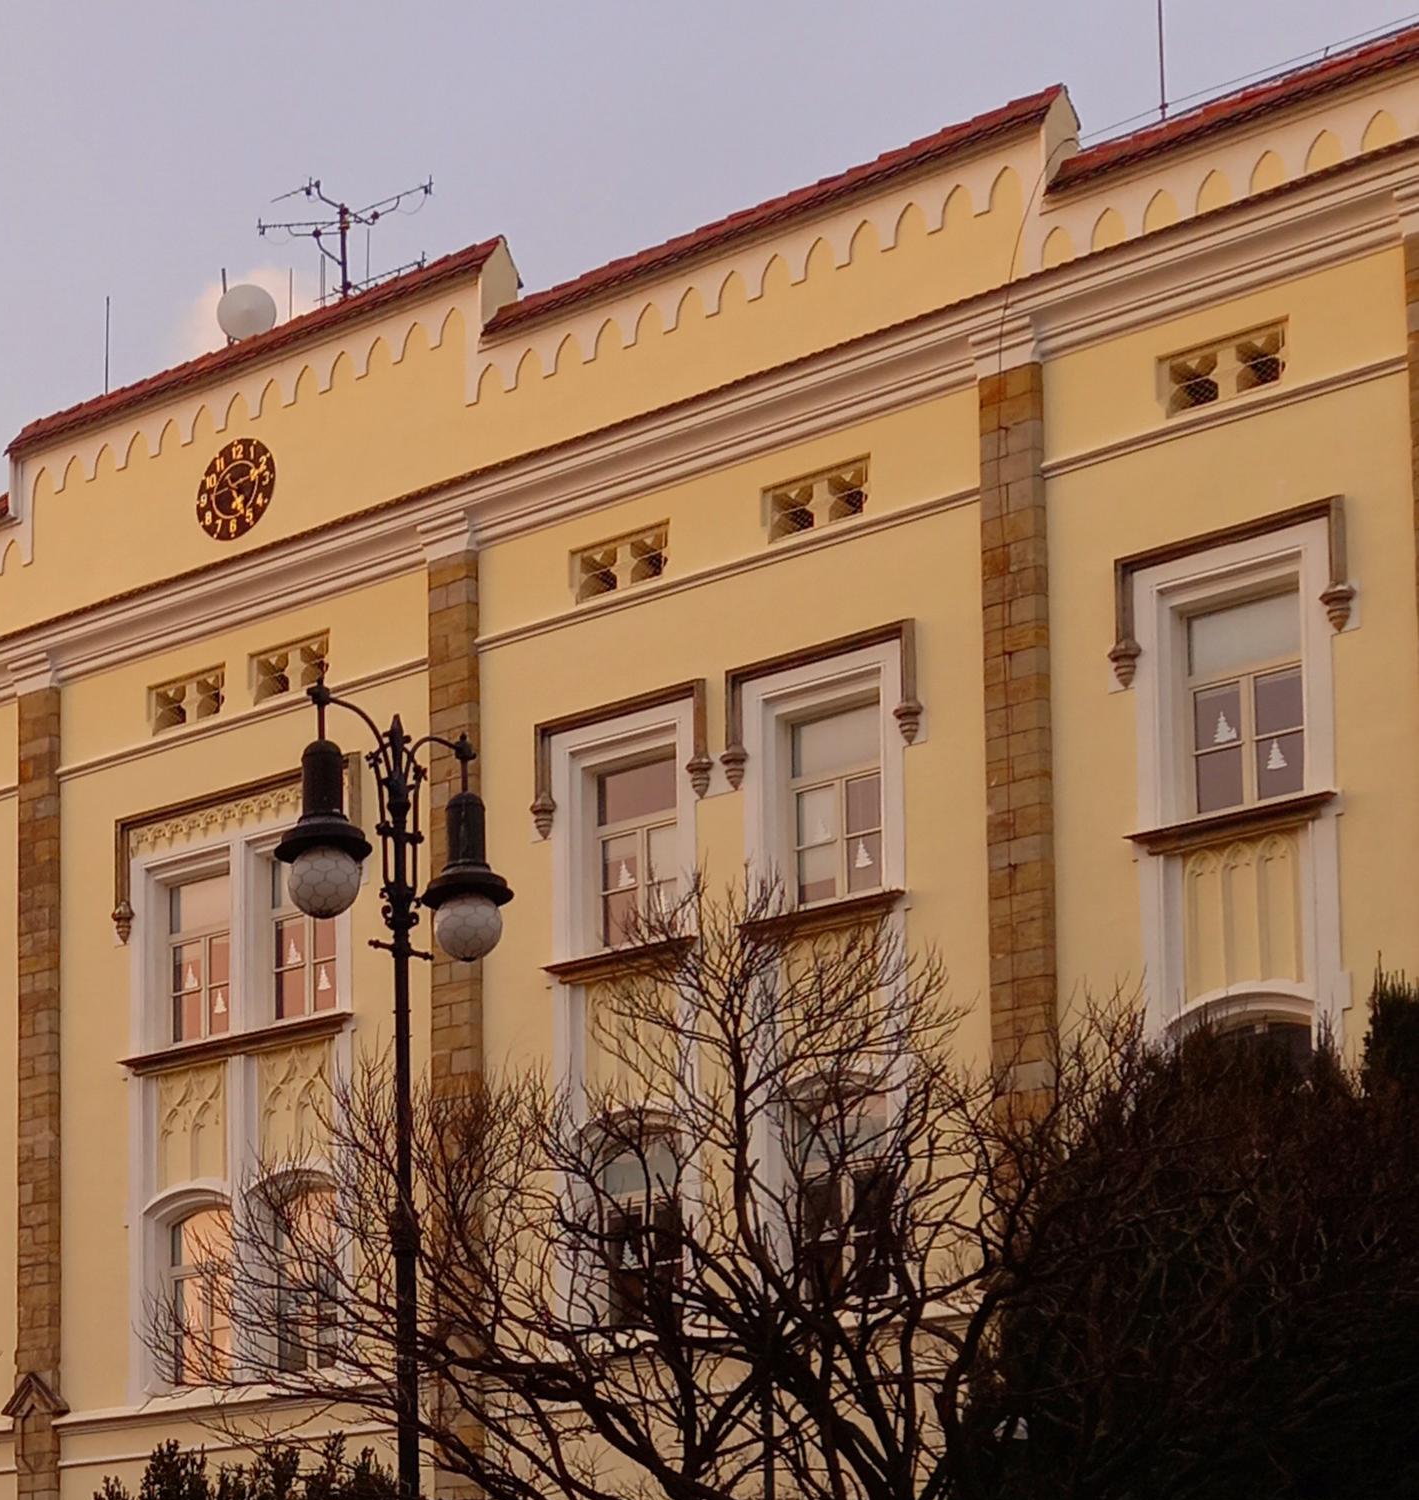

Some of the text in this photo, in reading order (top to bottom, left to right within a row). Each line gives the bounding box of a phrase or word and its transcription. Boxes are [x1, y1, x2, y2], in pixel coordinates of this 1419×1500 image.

[231, 444, 244, 459] 12
[249, 445, 255, 459] 1
[215, 456, 225, 472] 11
[258, 455, 267, 470] 2
[205, 473, 217, 489] 10
[261, 471, 270, 486] 3
[199, 493, 208, 508] 9
[256, 492, 263, 507] 4
[204, 510, 212, 525] 8
[245, 508, 253, 524] 5
[215, 519, 222, 535] 7
[229, 518, 237, 533] 6
